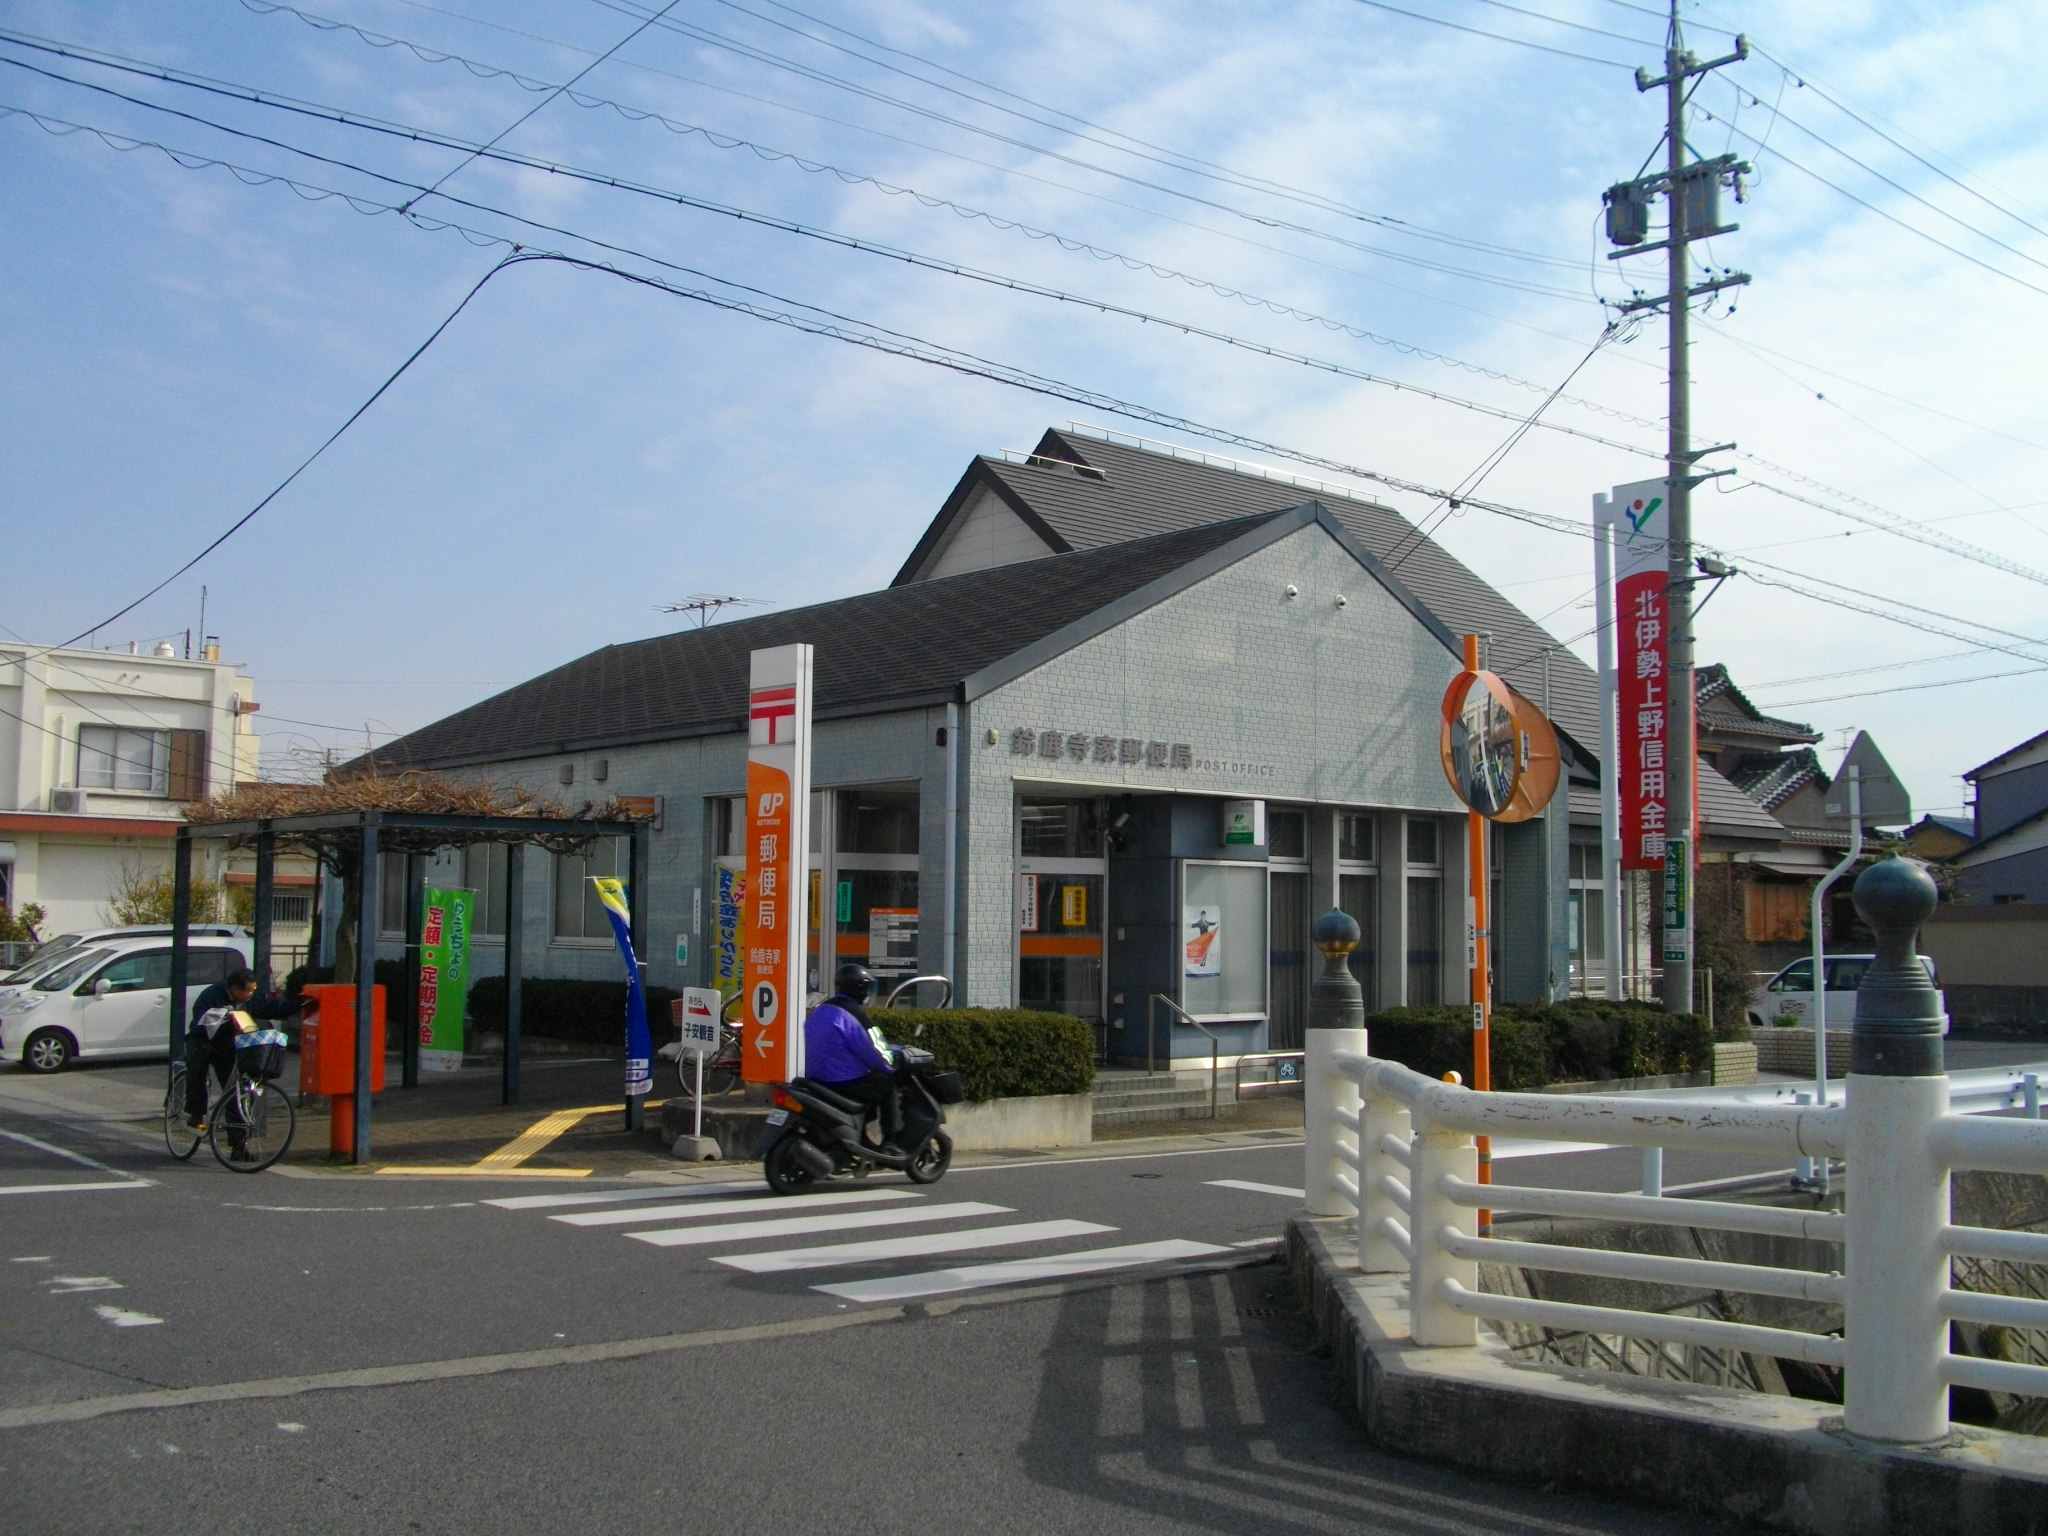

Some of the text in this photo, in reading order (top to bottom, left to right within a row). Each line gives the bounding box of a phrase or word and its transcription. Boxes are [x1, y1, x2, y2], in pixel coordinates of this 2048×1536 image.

[1635, 589, 1666, 860] 北伊勢上野信用金庫
[1011, 727, 1194, 770] 鈴鹿寺家郵便局
[1195, 759, 1276, 777] POST OFFICE
[758, 834, 778, 930] 郵便局
[448, 899, 466, 981] ゆうちょの
[750, 947, 781, 964] 鈴鹿寺家
[418, 906, 444, 1045] 定額・定期貯金
[688, 996, 703, 1006] あちら
[758, 986, 773, 1018] P
[684, 1022, 715, 1042] 子安観音
